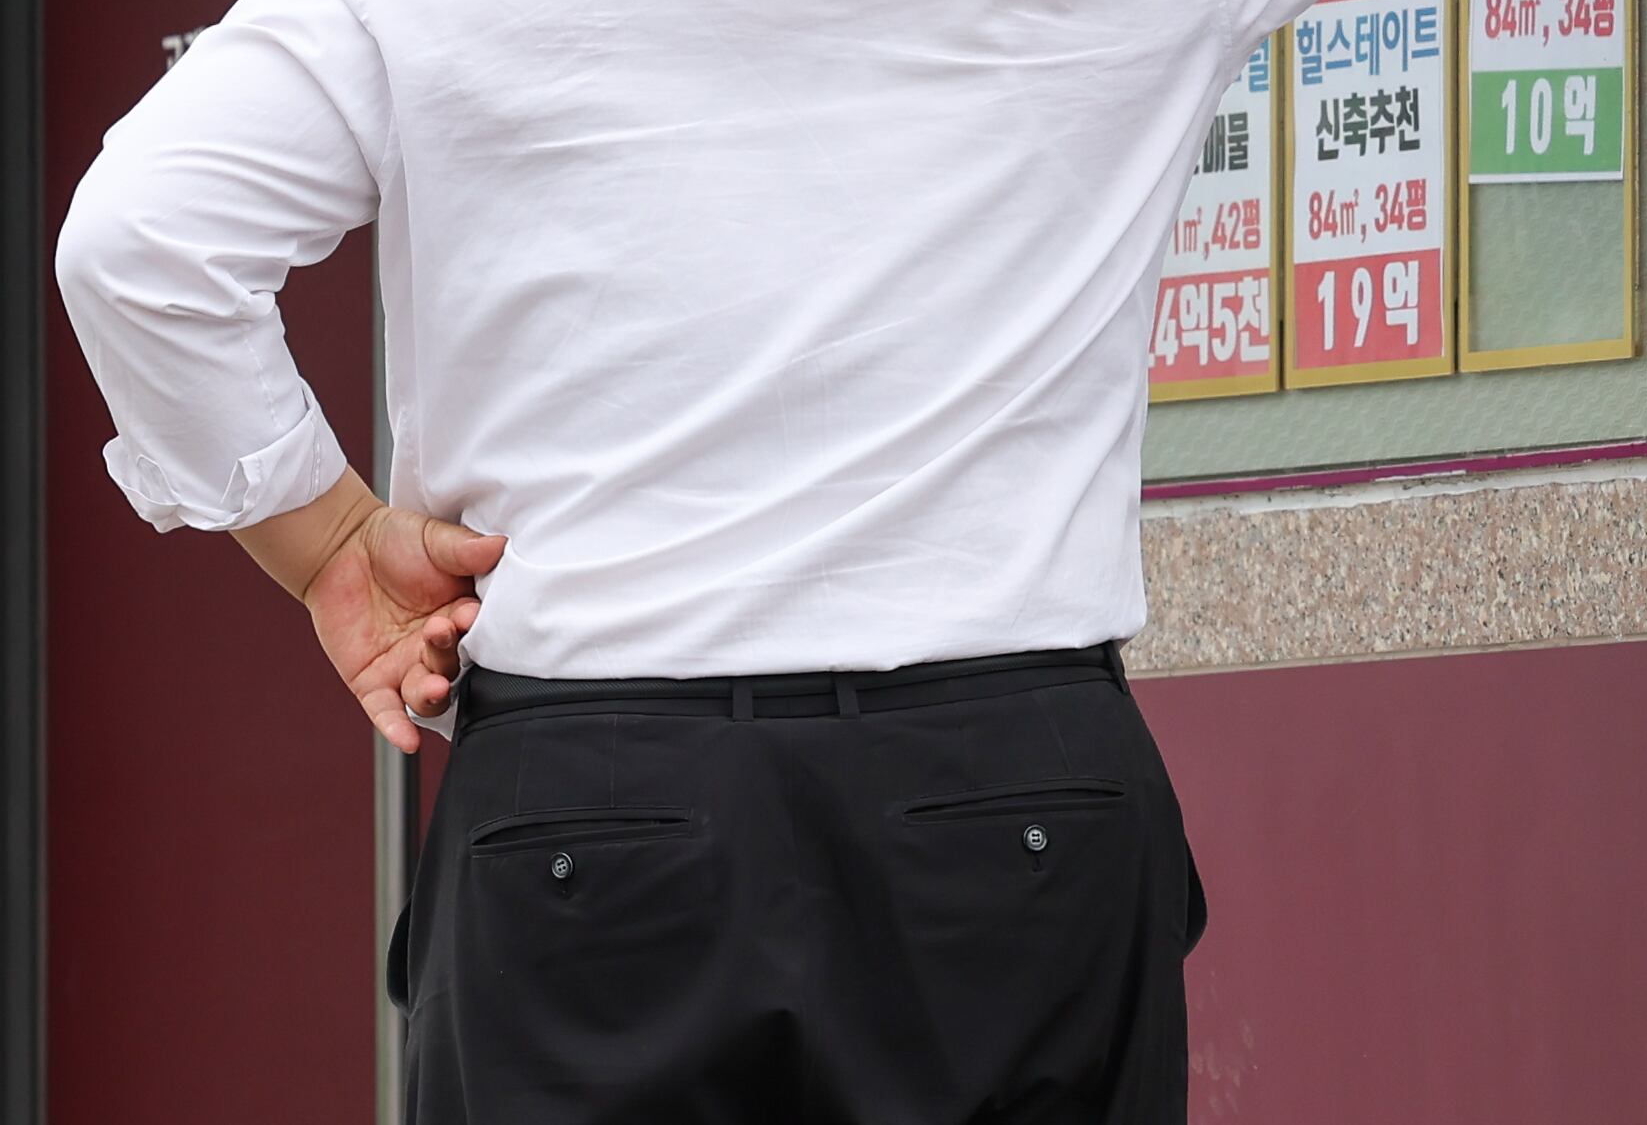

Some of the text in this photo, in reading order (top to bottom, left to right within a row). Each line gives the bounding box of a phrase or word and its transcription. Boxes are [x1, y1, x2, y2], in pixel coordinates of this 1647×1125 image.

[1297, 5, 1440, 84] 힐스테이트
[1317, 86, 1420, 161] 신축추천
[1375, 179, 1426, 232] 34평
[1149, 277, 1269, 366] 4억5천
